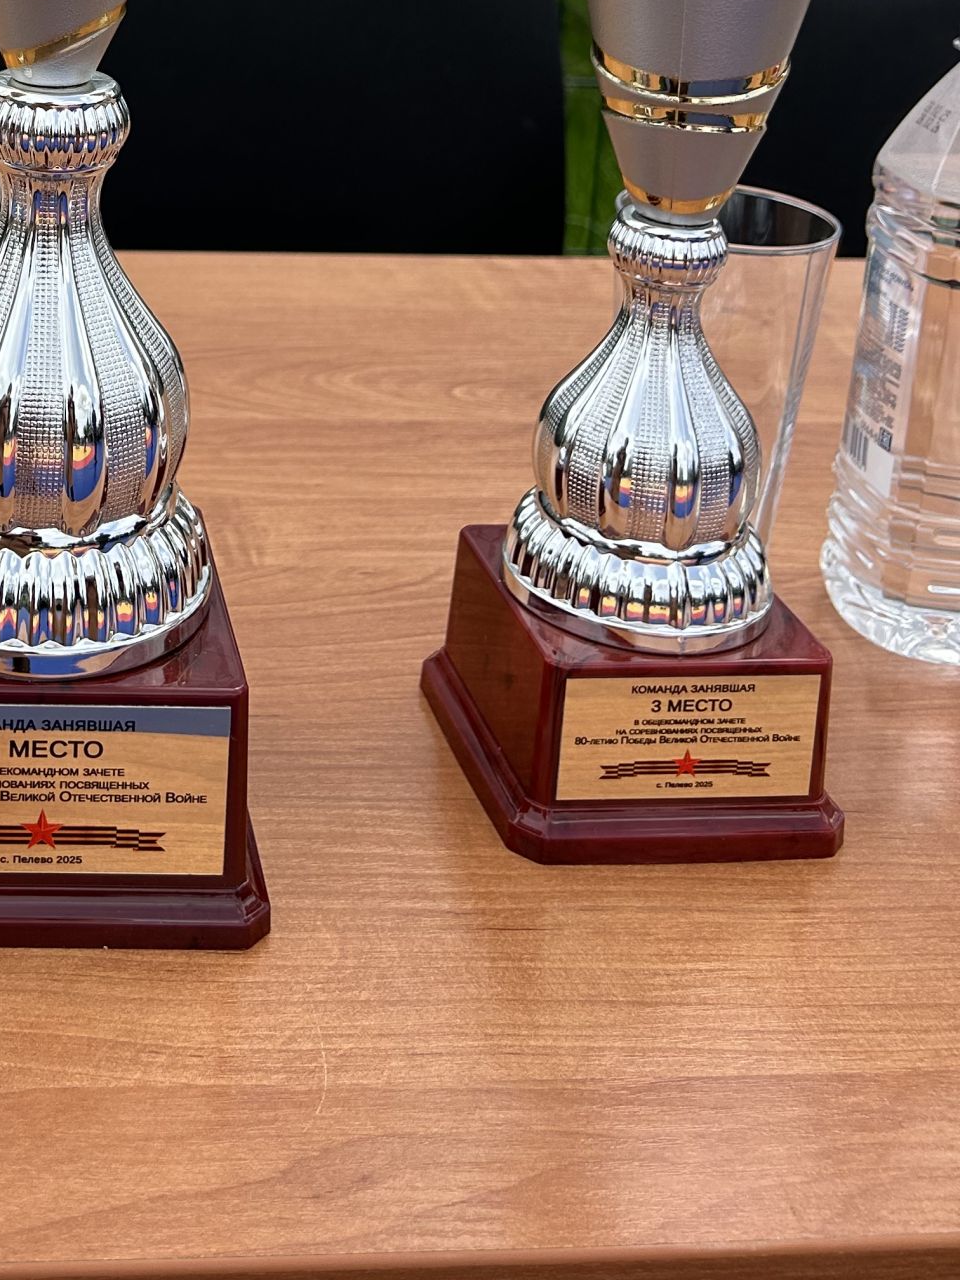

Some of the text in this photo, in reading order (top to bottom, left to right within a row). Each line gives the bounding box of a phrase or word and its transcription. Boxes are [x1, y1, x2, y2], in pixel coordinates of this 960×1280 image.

[632, 684, 755, 695] КОМАНДА ЗАНЯВШАЯ
[651, 699, 732, 712] 3 МЕСТО
[41, 719, 136, 732] ЗАНЯВШАЯ
[9, 740, 104, 758] МЕСТО
[57, 855, 82, 864] 2025
